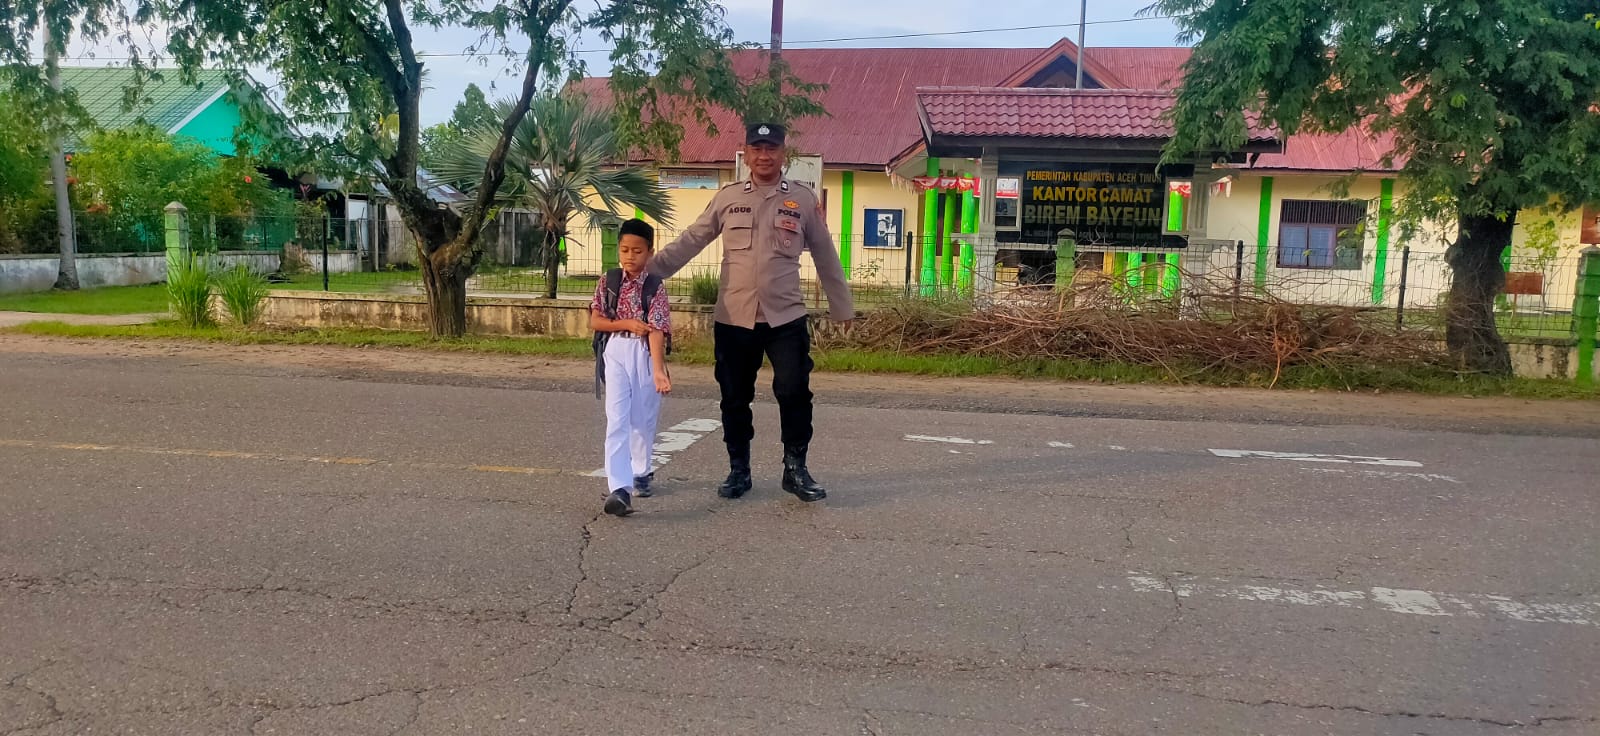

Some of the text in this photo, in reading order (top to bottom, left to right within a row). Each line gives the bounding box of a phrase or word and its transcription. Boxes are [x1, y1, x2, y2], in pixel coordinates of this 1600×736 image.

[1027, 171, 1162, 184] PEMERINTAH KABUPATEN ACEH TIMUR
[1033, 187, 1153, 202] KANTOR CAMAT
[778, 209, 801, 218] POLRI
[1025, 205, 1160, 225] BIREM BAYEUN
